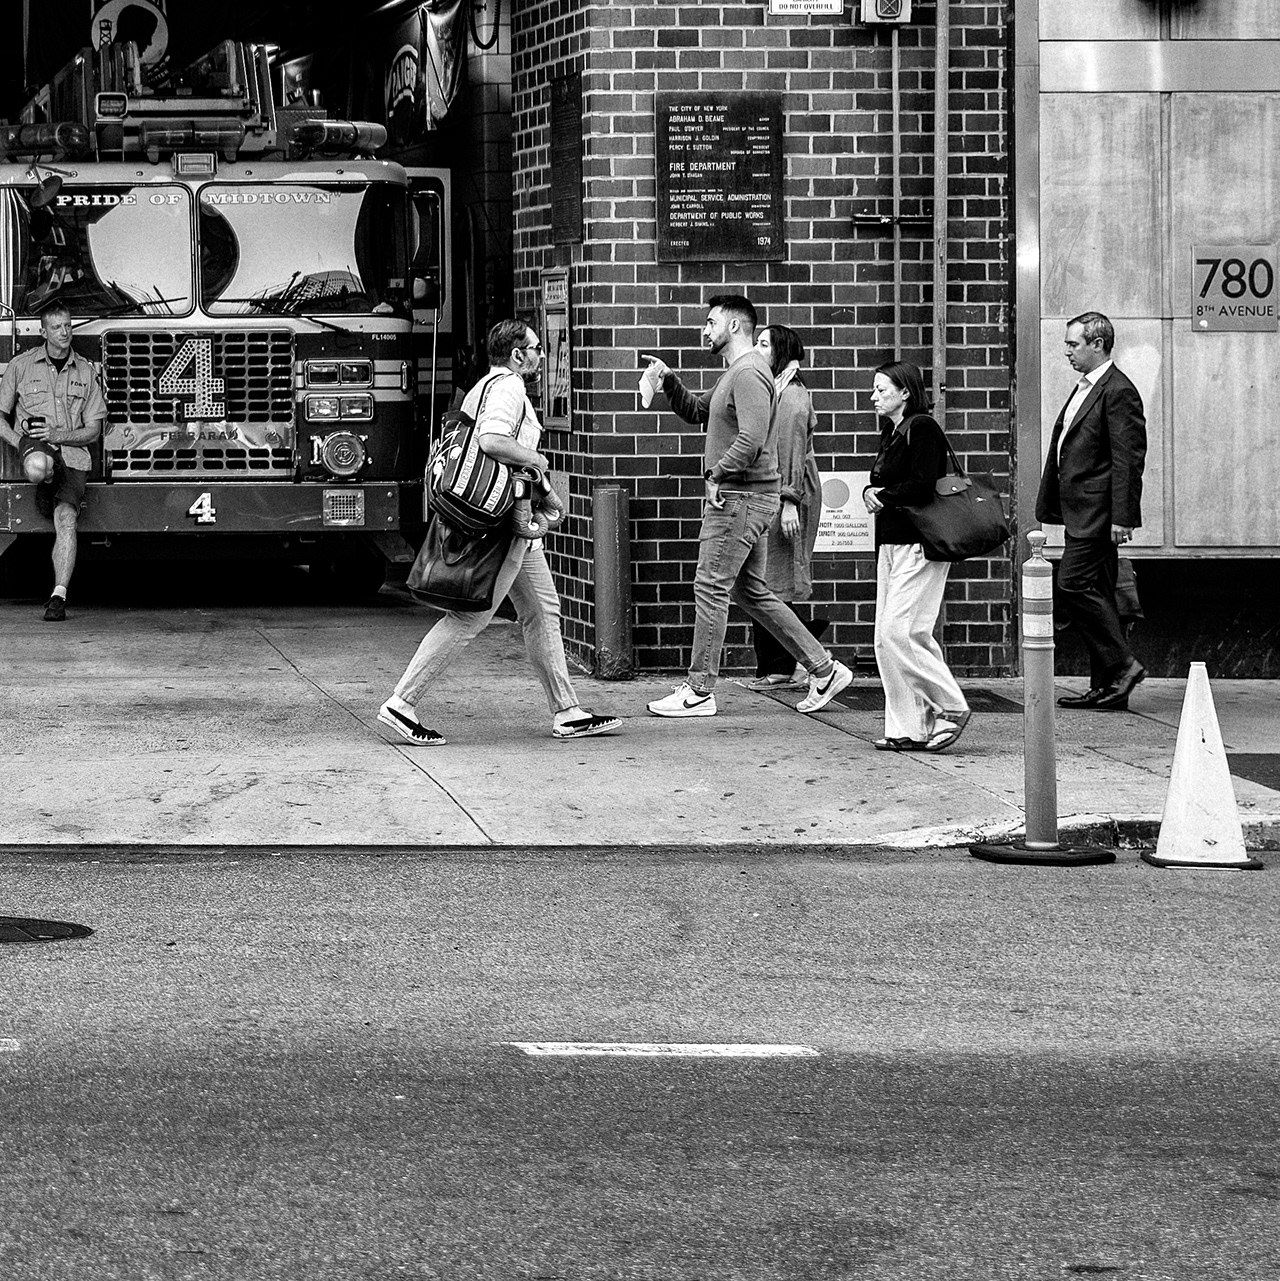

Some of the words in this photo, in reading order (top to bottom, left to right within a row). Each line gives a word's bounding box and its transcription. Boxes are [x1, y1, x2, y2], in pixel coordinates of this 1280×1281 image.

[669, 115, 696, 123] ABRAHAM
[669, 162, 686, 171] FIRE
[689, 162, 737, 171] DEPARTMENT
[56, 193, 138, 205] PRIDE
[149, 194, 183, 205] OF
[700, 194, 724, 202] SERVICE
[727, 193, 772, 201] ADMINISTRATION
[669, 212, 707, 220] DEPARTMENT
[709, 212, 719, 220] OF
[721, 212, 743, 220] PUBLIC
[744, 211, 765, 219] WORKS
[757, 237, 771, 246] 1974
[1196, 258, 1274, 299] 780
[1219, 305, 1274, 317] AVENUE
[159, 339, 225, 418] 4
[189, 492, 216, 523] 4
